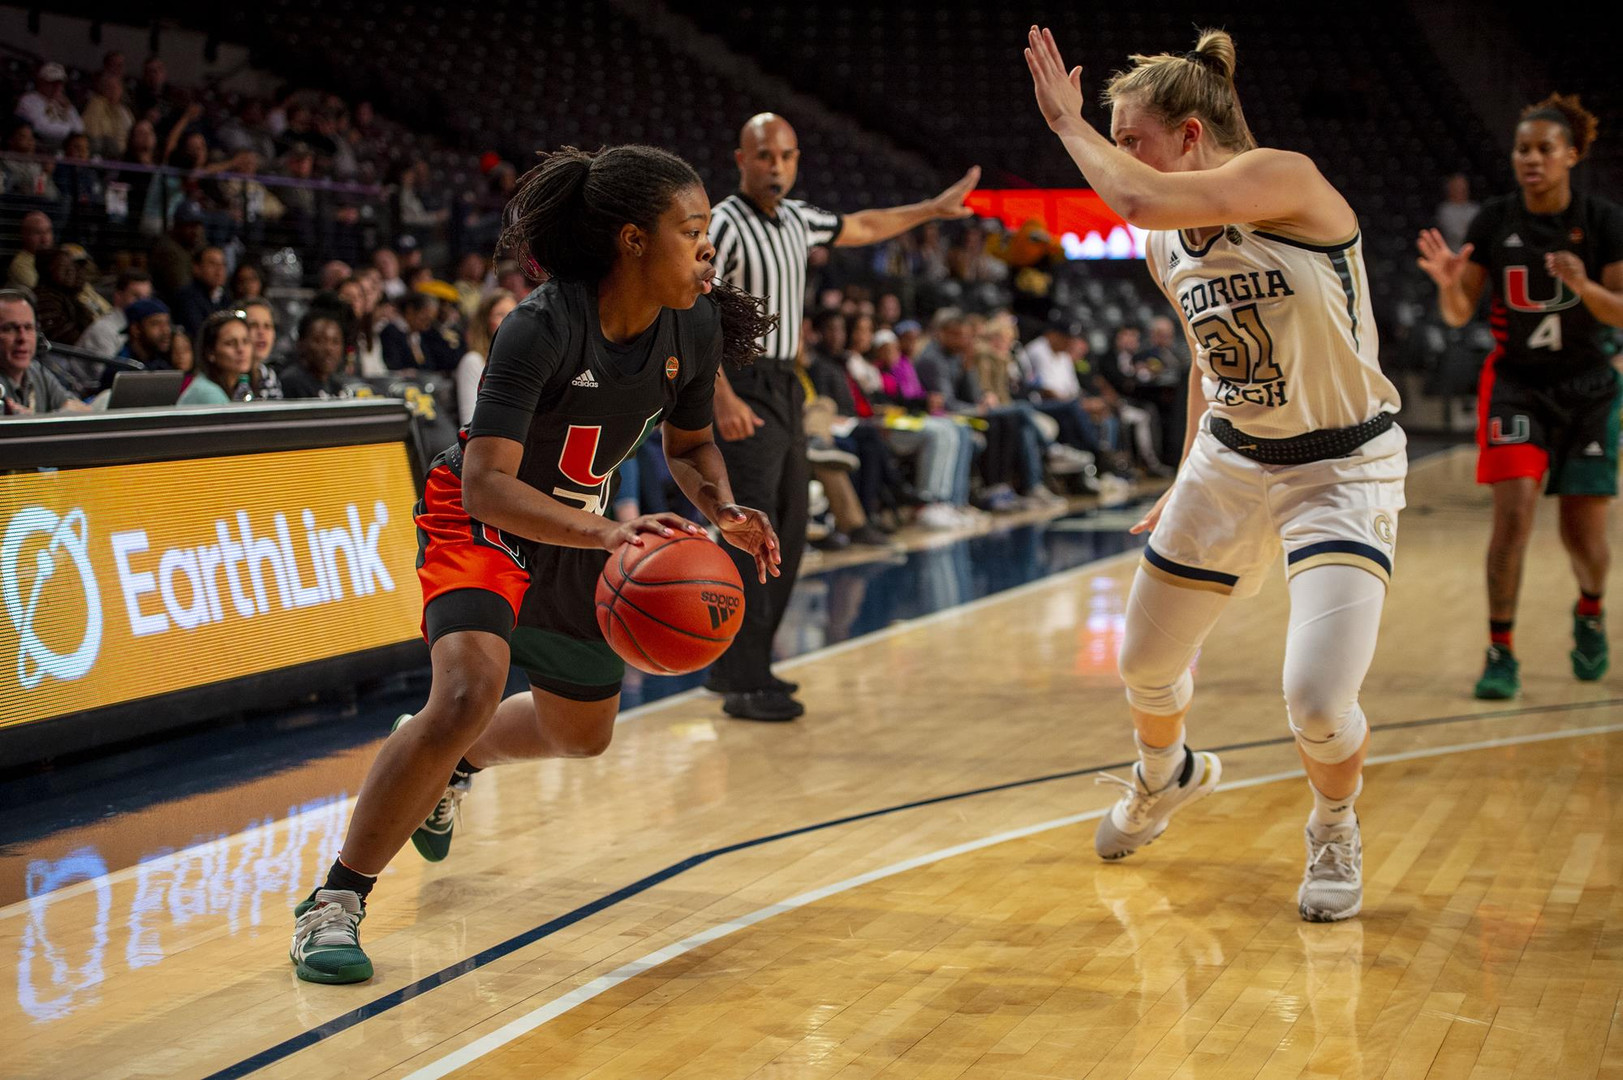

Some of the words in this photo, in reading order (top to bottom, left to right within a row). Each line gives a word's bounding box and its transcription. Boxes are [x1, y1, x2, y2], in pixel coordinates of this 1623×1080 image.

[1181, 269, 1295, 322] EORGIA
[1192, 302, 1284, 384] 31
[1527, 312, 1564, 351] 4
[571, 379, 599, 388] adidas
[1214, 377, 1289, 408] TECH
[111, 501, 396, 637] EarthLink
[701, 591, 740, 608] adidas
